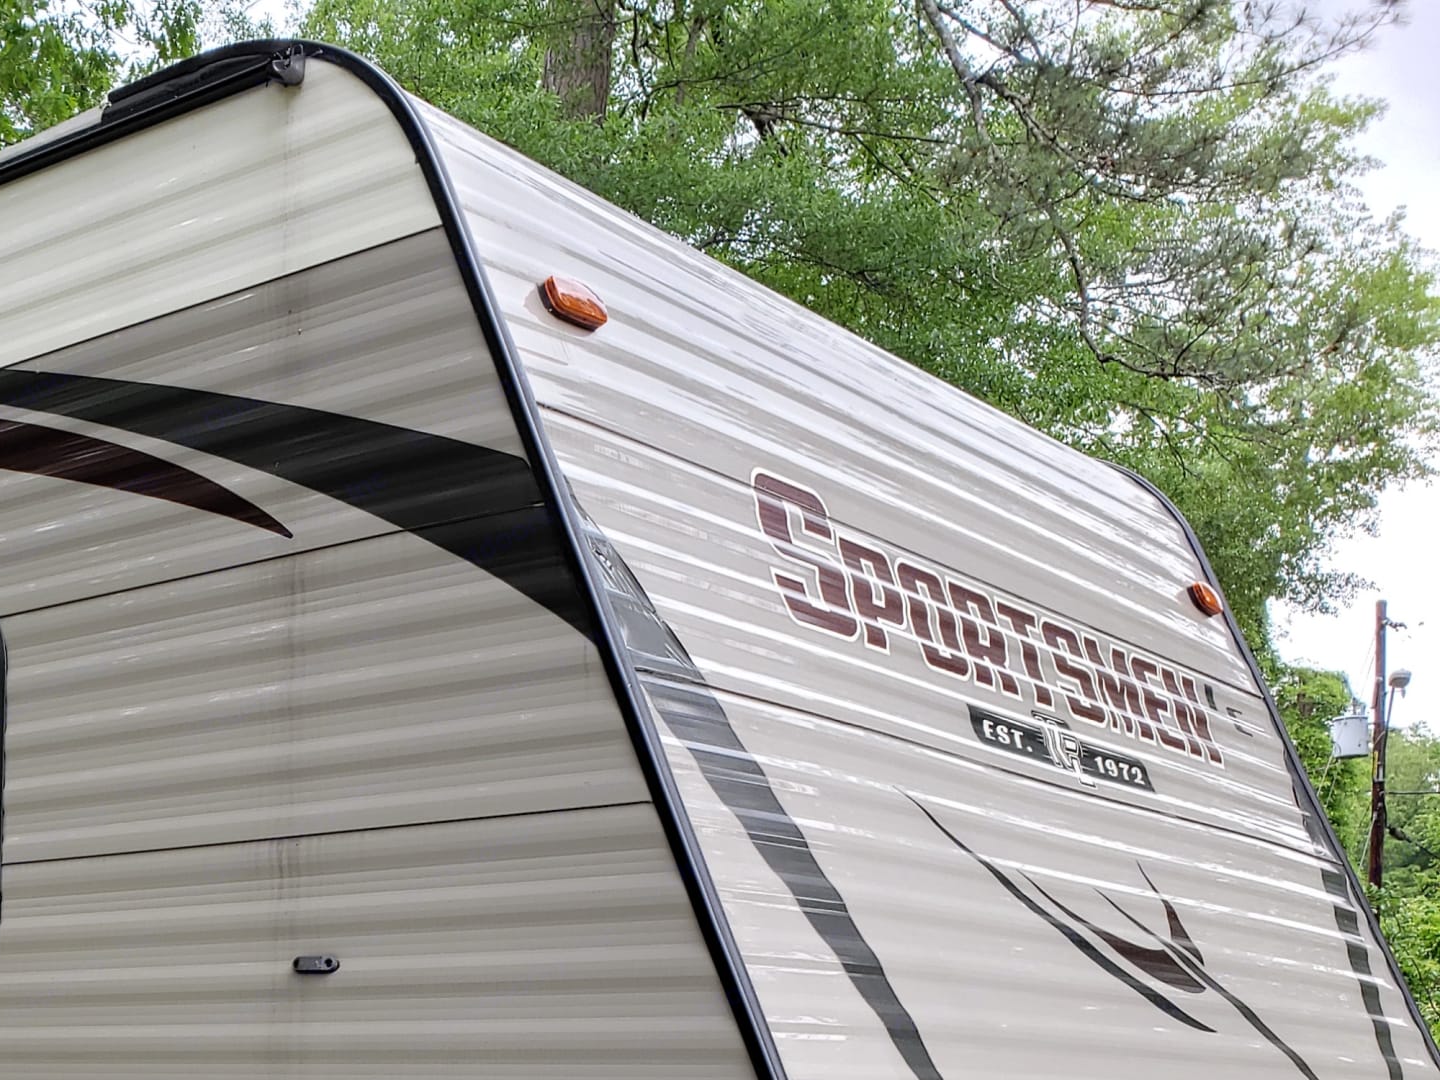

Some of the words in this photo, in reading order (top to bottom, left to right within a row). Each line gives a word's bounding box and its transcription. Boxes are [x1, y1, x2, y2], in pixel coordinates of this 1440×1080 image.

[750, 467, 1225, 769] SPORTSMEN
[981, 719, 1034, 753] EST.
[1093, 754, 1146, 786] 1972
